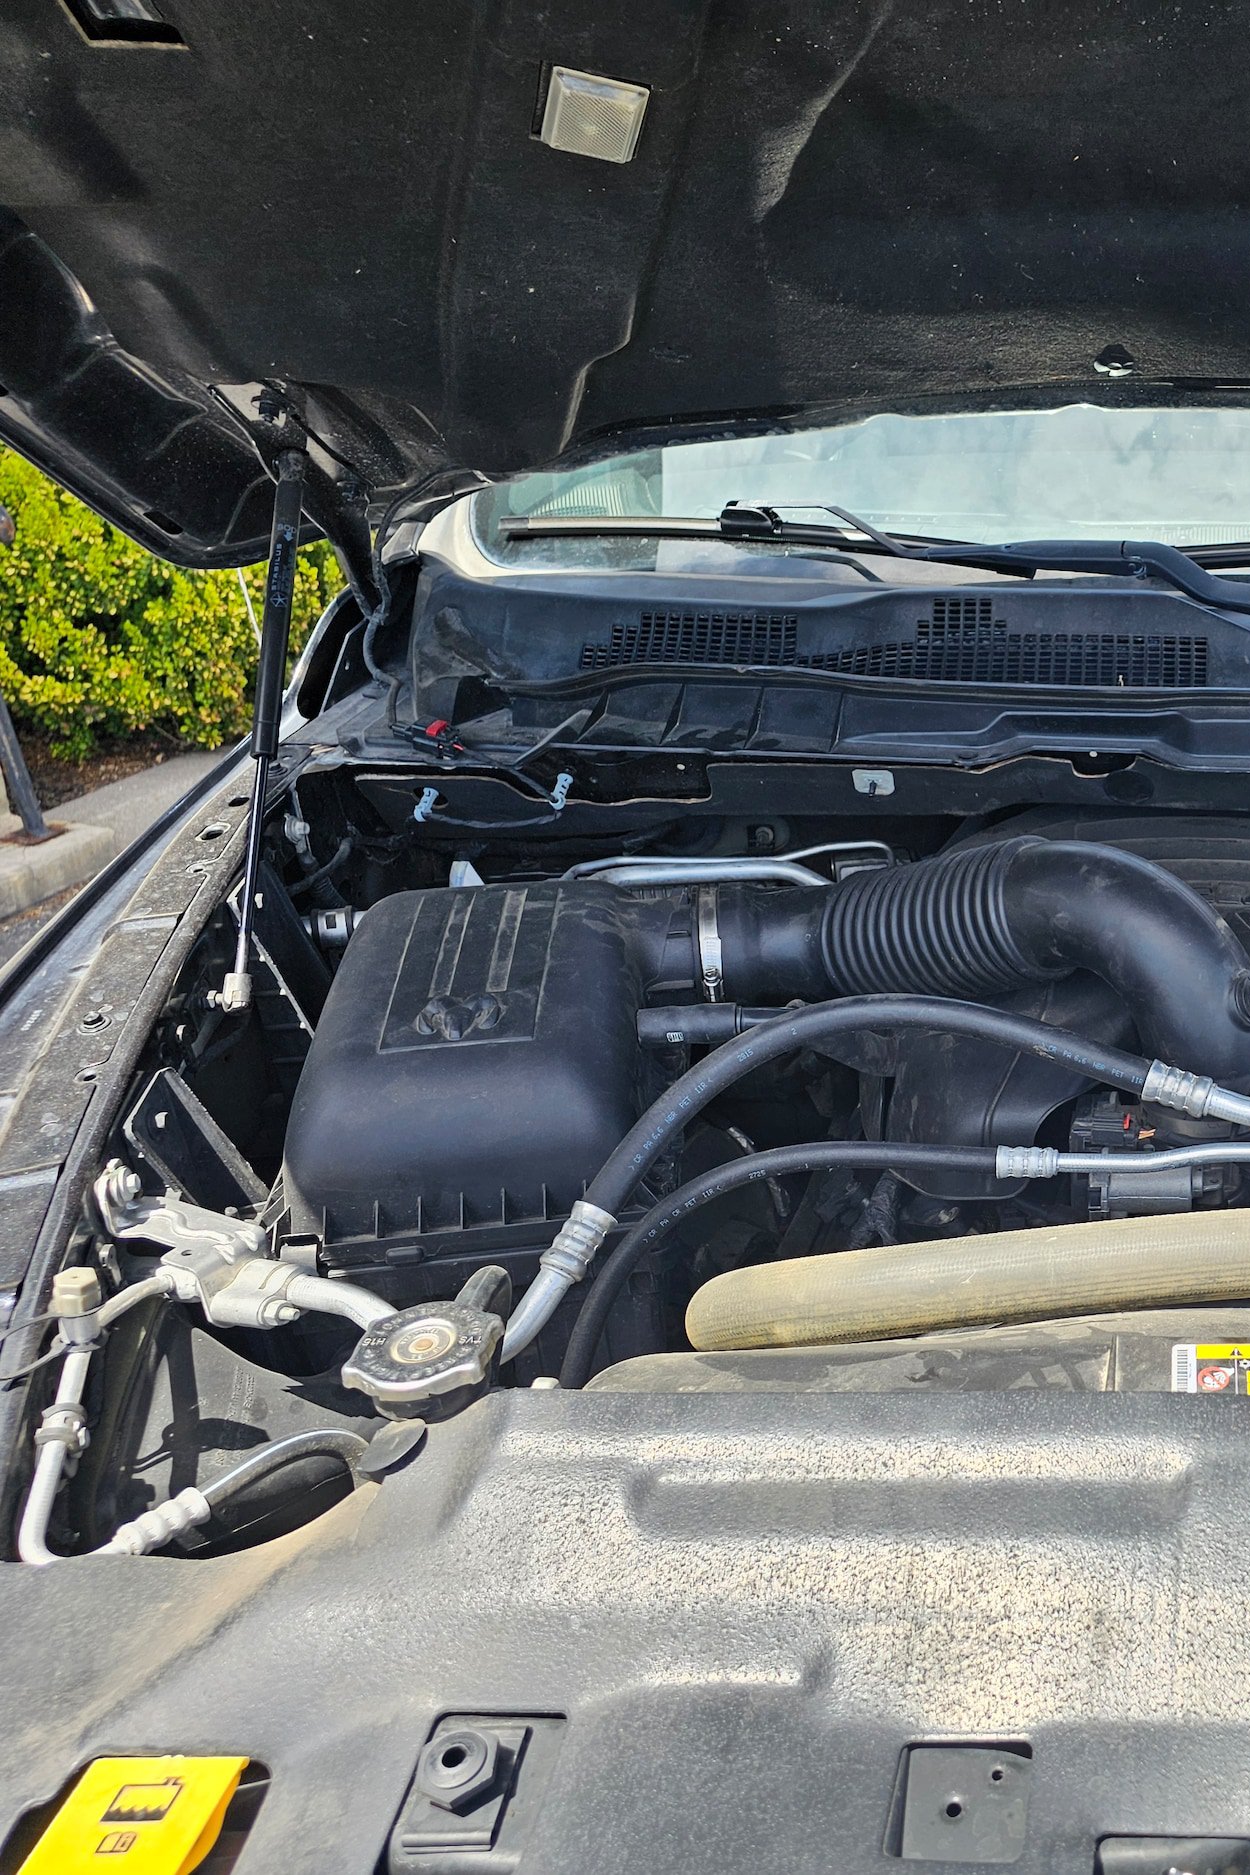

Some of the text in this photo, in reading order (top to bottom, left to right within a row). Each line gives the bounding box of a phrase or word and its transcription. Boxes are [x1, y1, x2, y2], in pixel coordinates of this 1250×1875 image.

[271, 543, 283, 591] STABILUS
[1111, 1068, 1125, 1079] PET
[633, 1152, 644, 1164] CR
[678, 1096, 693, 1109] PET
[694, 1081, 708, 1094] IIR
[790, 1027, 798, 1036] 2
[648, 1228, 658, 1238] CR
[659, 1217, 670, 1228] PA
[671, 1208, 681, 1218] CR
[684, 1197, 697, 1209] PET
[701, 1187, 715, 1199] IIR
[361, 1336, 388, 1346] H16
[457, 1335, 483, 1345] TVS
